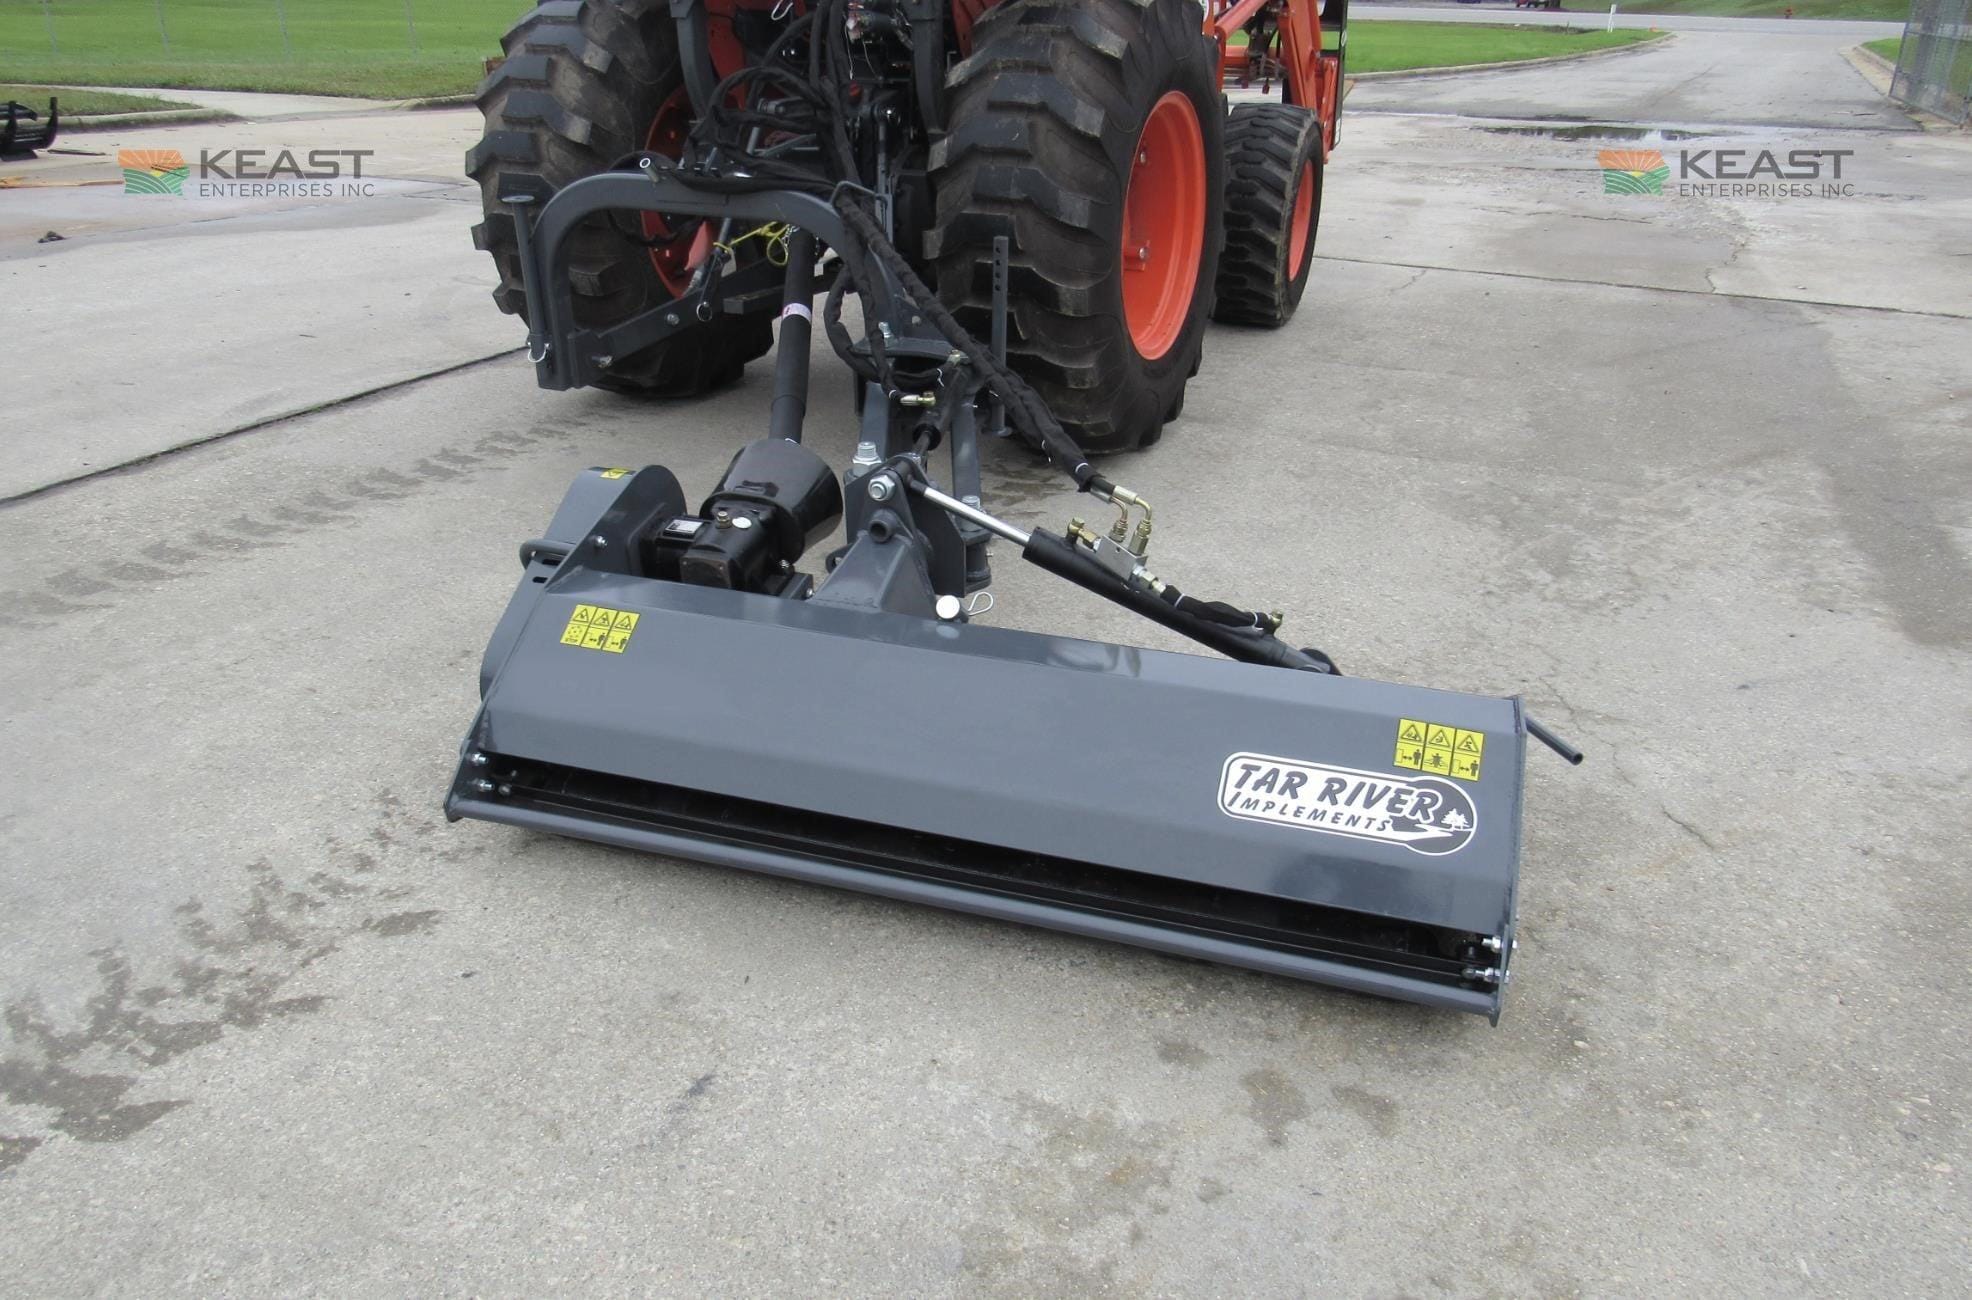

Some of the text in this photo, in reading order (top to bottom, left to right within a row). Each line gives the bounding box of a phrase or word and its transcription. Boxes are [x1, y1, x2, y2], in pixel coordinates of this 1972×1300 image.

[1227, 791, 1391, 831] IMPLEMENTS
[1234, 764, 1439, 821] TAR RIVER
